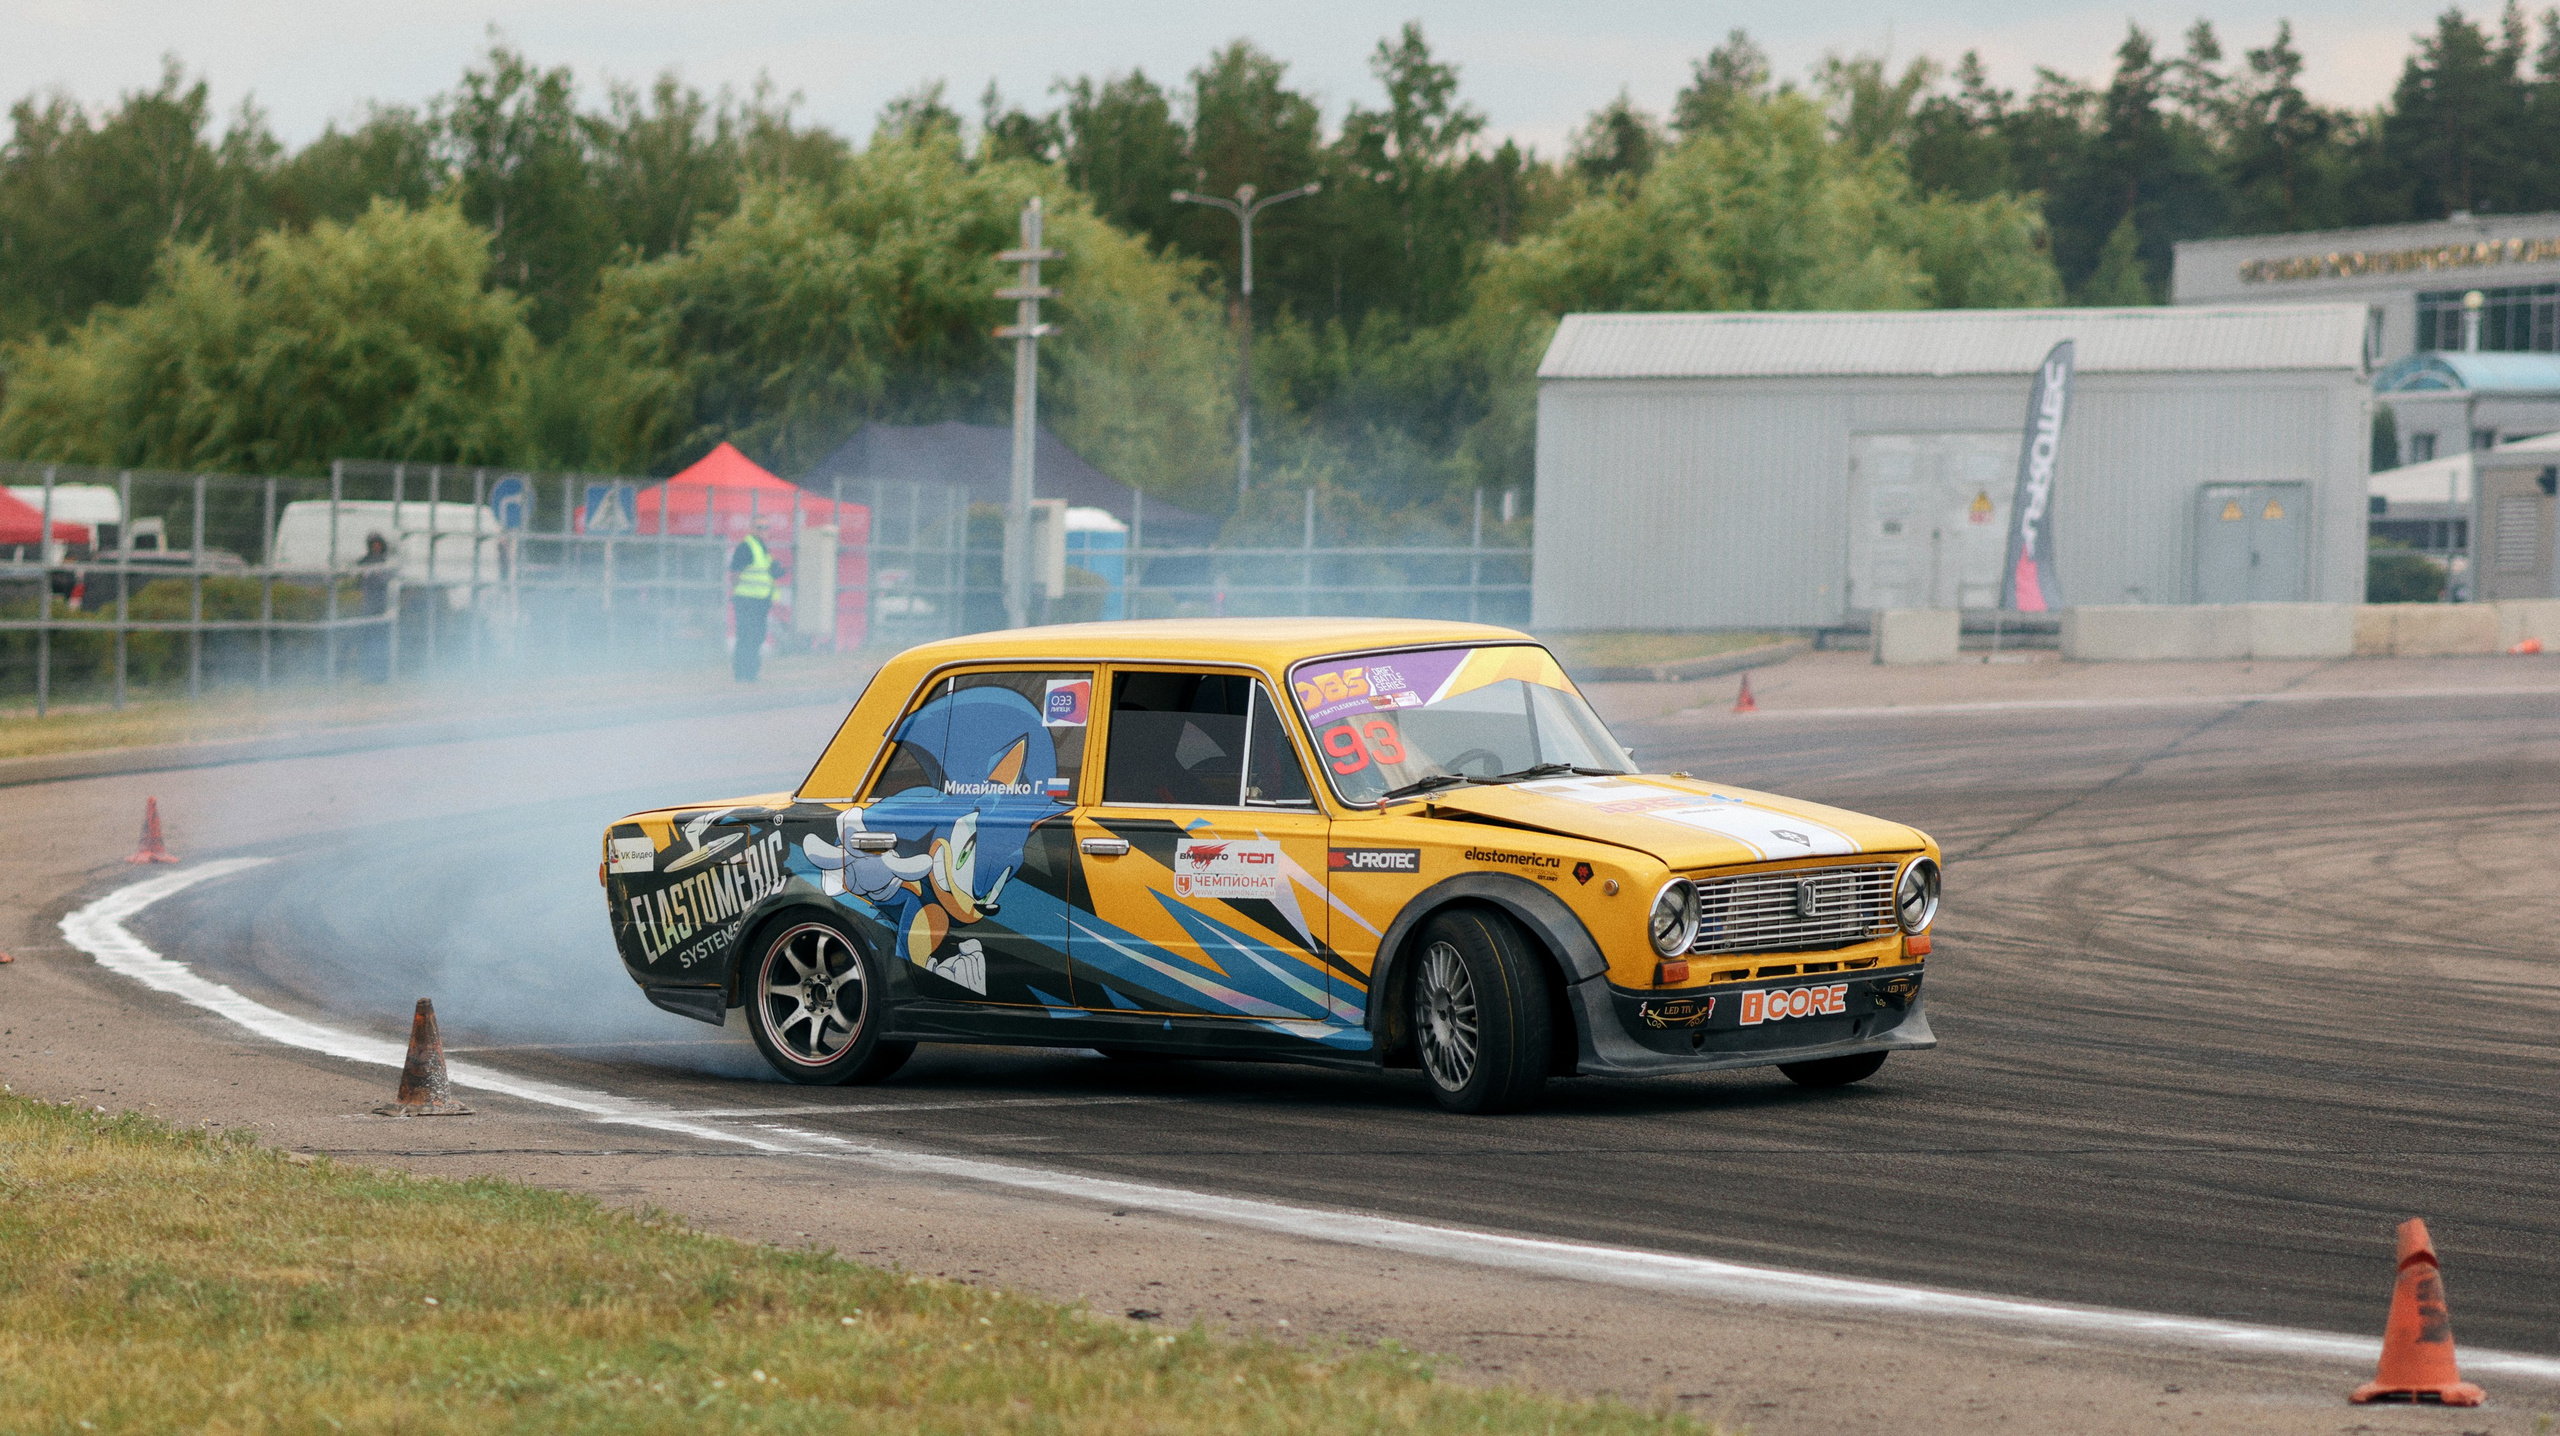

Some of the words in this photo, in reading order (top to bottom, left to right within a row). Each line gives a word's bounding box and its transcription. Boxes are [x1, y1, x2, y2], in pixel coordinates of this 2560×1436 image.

[1370, 665, 1394, 677] DRIFT
[1372, 672, 1405, 684] BATTLE
[1294, 667, 1370, 712] DBS
[1375, 680, 1407, 692] SERIES
[1051, 695, 1072, 706] ОЭЗ
[1322, 720, 1406, 776] 93
[943, 780, 1031, 795] Михайленко
[1034, 780, 1045, 795] Г.
[620, 851, 631, 860] VK
[631, 851, 653, 860] Видео
[1237, 852, 1275, 864] ТОП
[1464, 847, 1560, 868] elastomeric.ru
[1195, 876, 1276, 888] ЧЕМПИОНАТ
[630, 829, 787, 965] ELASTOMERIC
[1194, 889, 1275, 897] WWW.CHAMPIONAT.COM
[679, 920, 741, 969] SYSTEMS
[1664, 1006, 1680, 1015] LED
